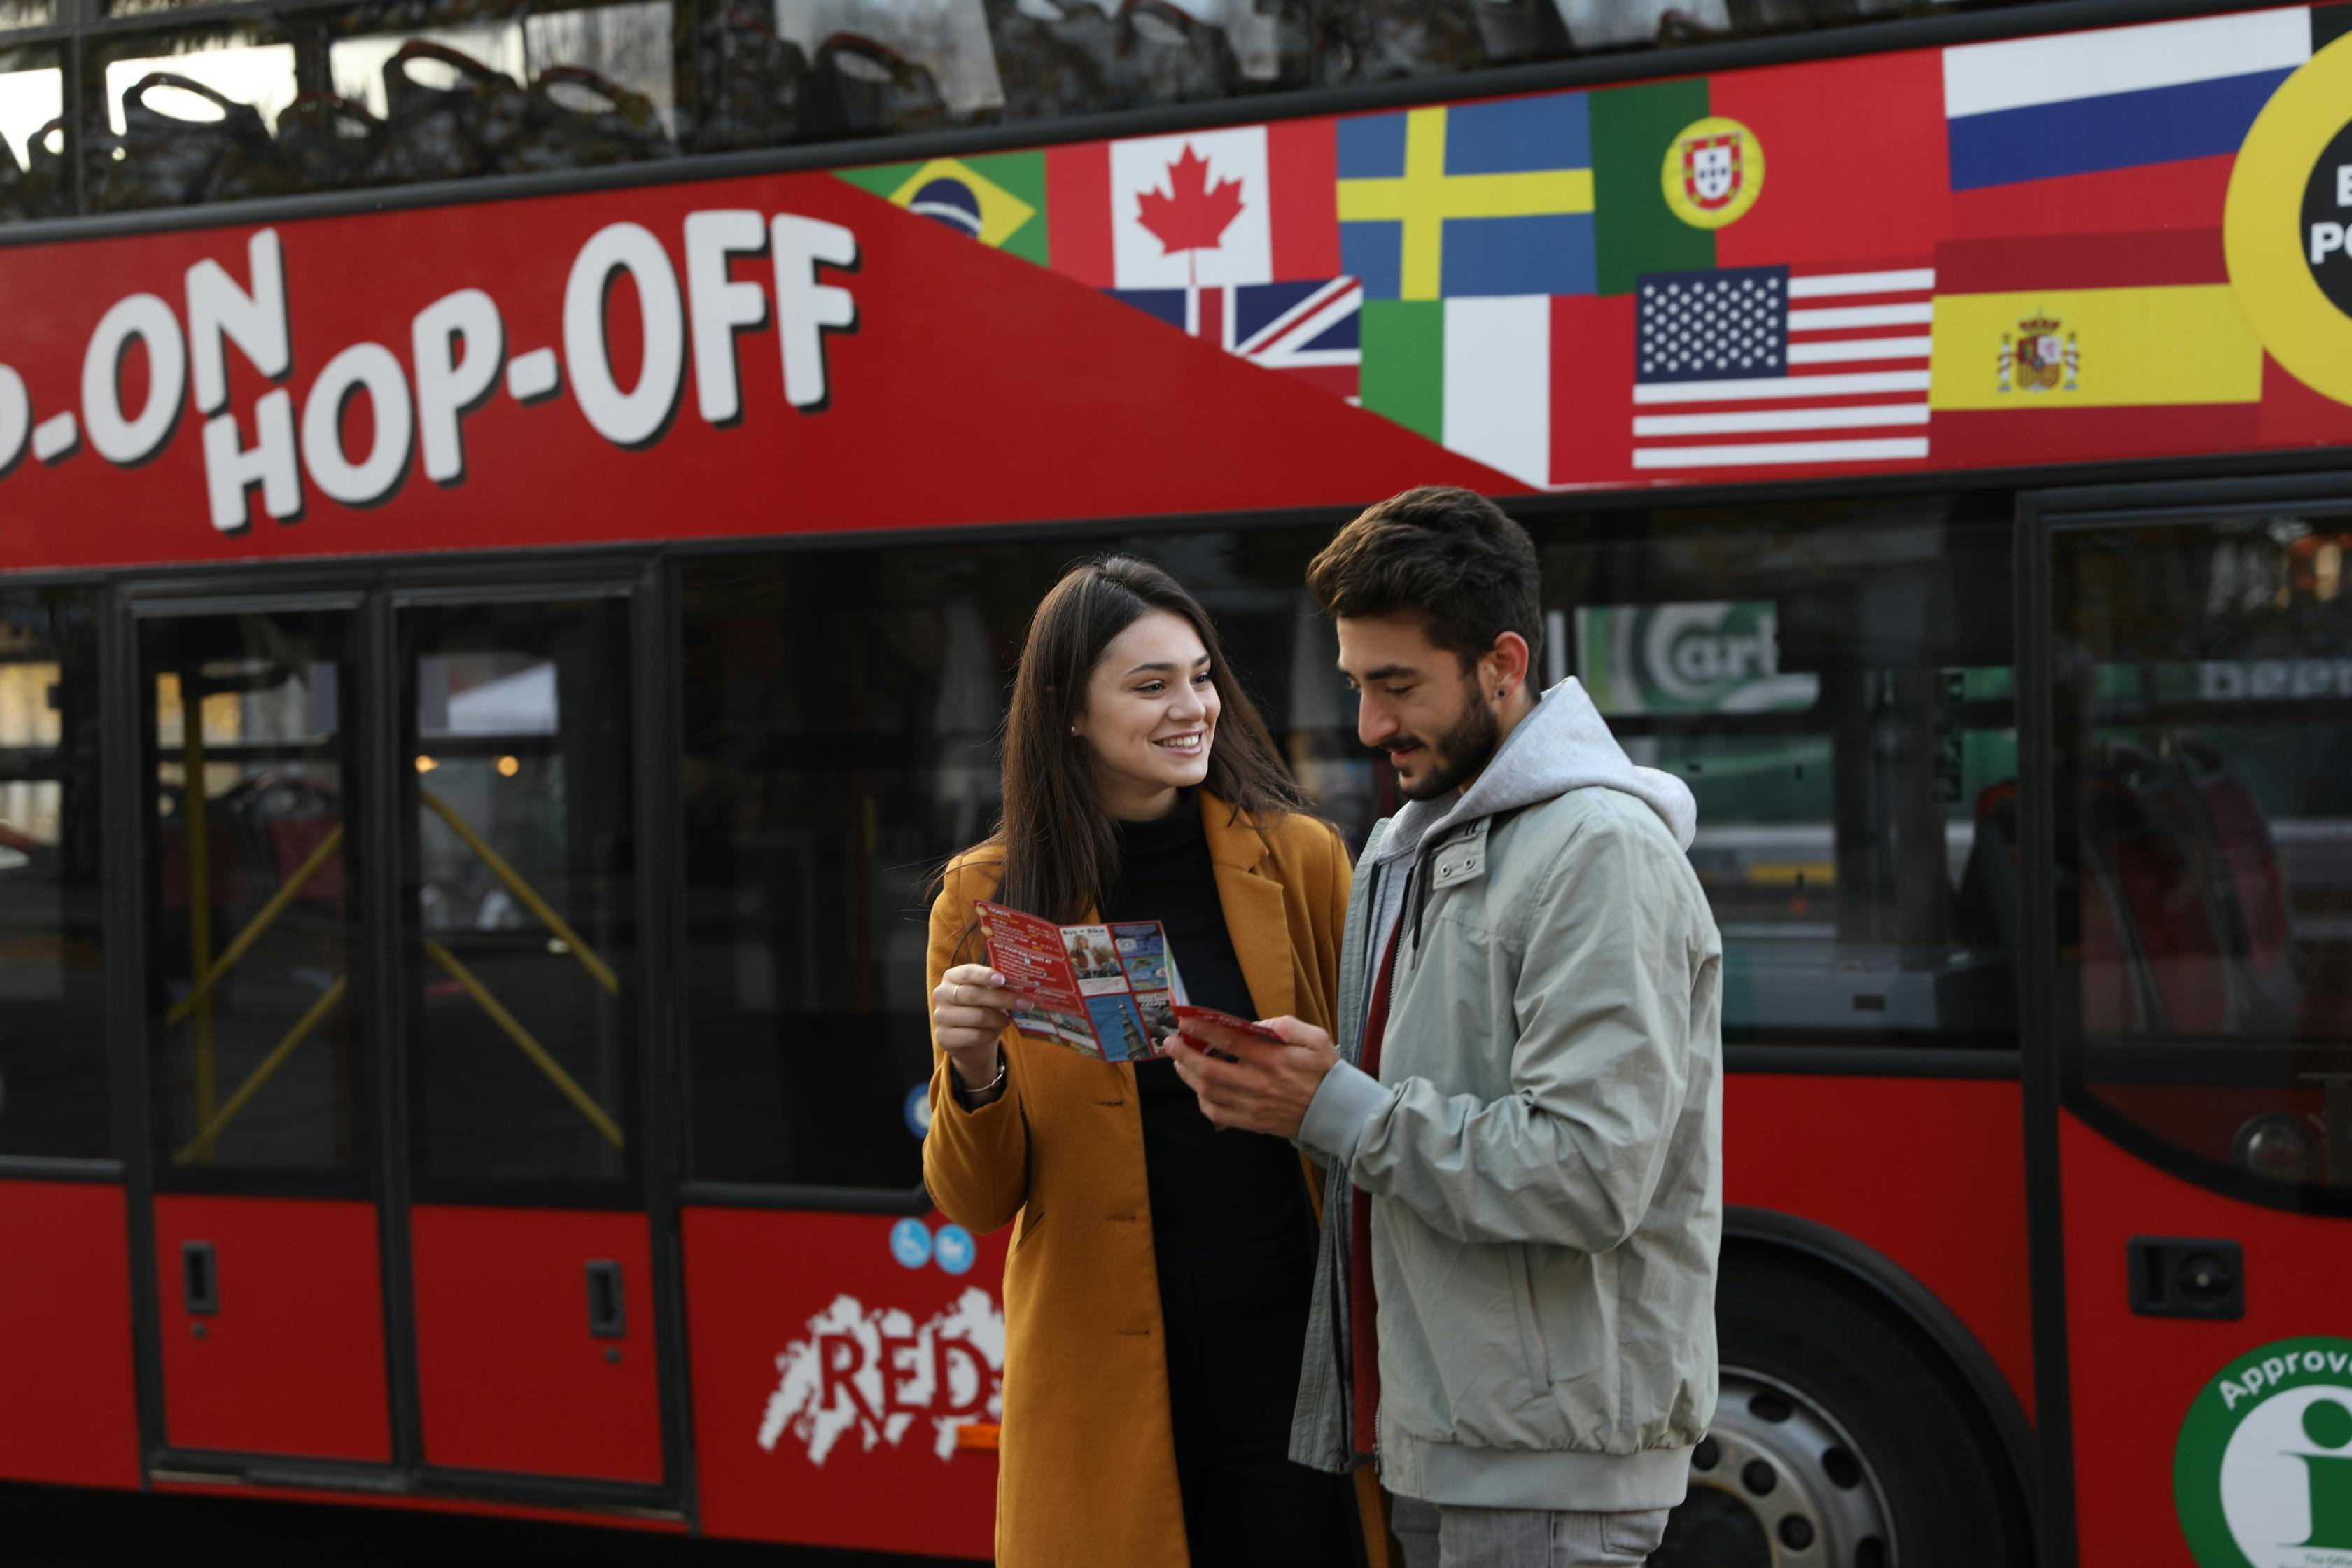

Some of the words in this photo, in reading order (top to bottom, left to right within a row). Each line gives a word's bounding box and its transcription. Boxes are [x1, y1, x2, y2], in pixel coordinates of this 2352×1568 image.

[2311, 221, 2352, 265] P
[202, 209, 857, 532] HOP-OFF
[2219, 1350, 2352, 1410] Approv
